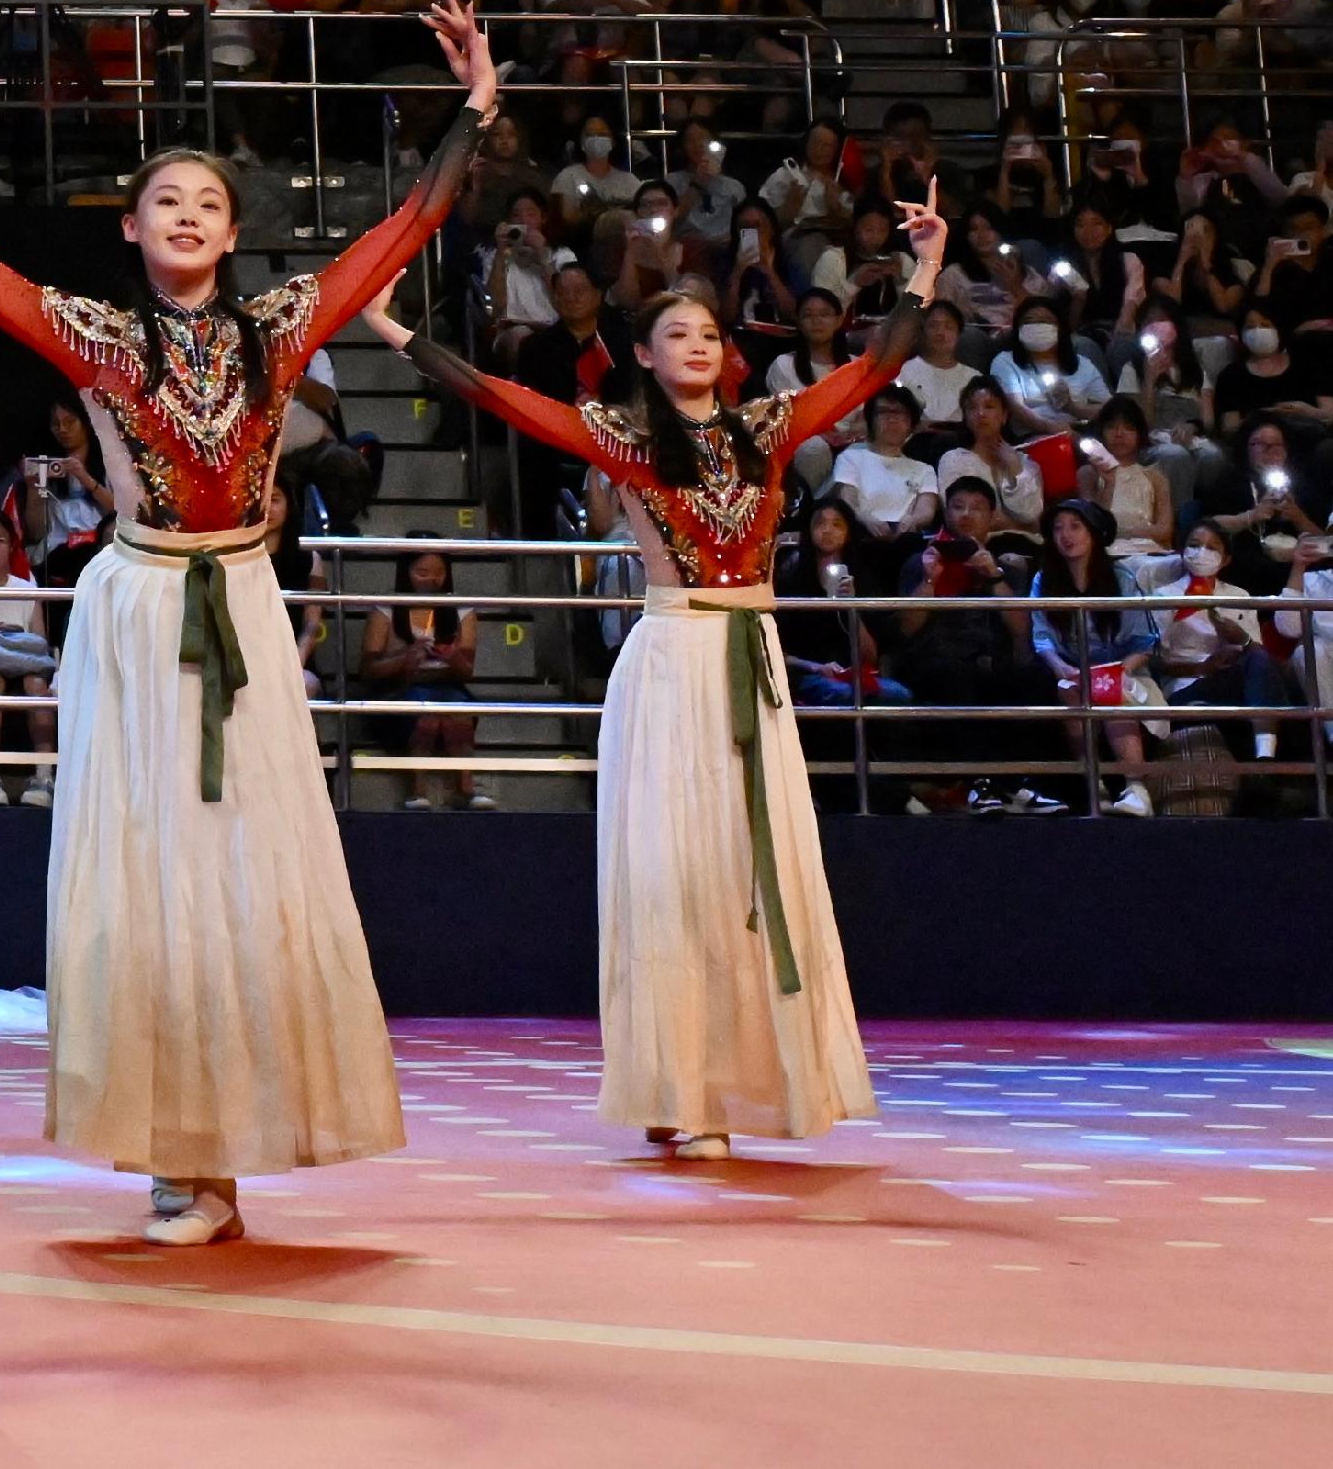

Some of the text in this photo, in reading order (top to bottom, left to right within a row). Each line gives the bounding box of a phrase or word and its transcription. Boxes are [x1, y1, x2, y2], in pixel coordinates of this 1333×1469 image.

[412, 398, 428, 418] F
[457, 509, 474, 527] E
[504, 623, 525, 646] D
